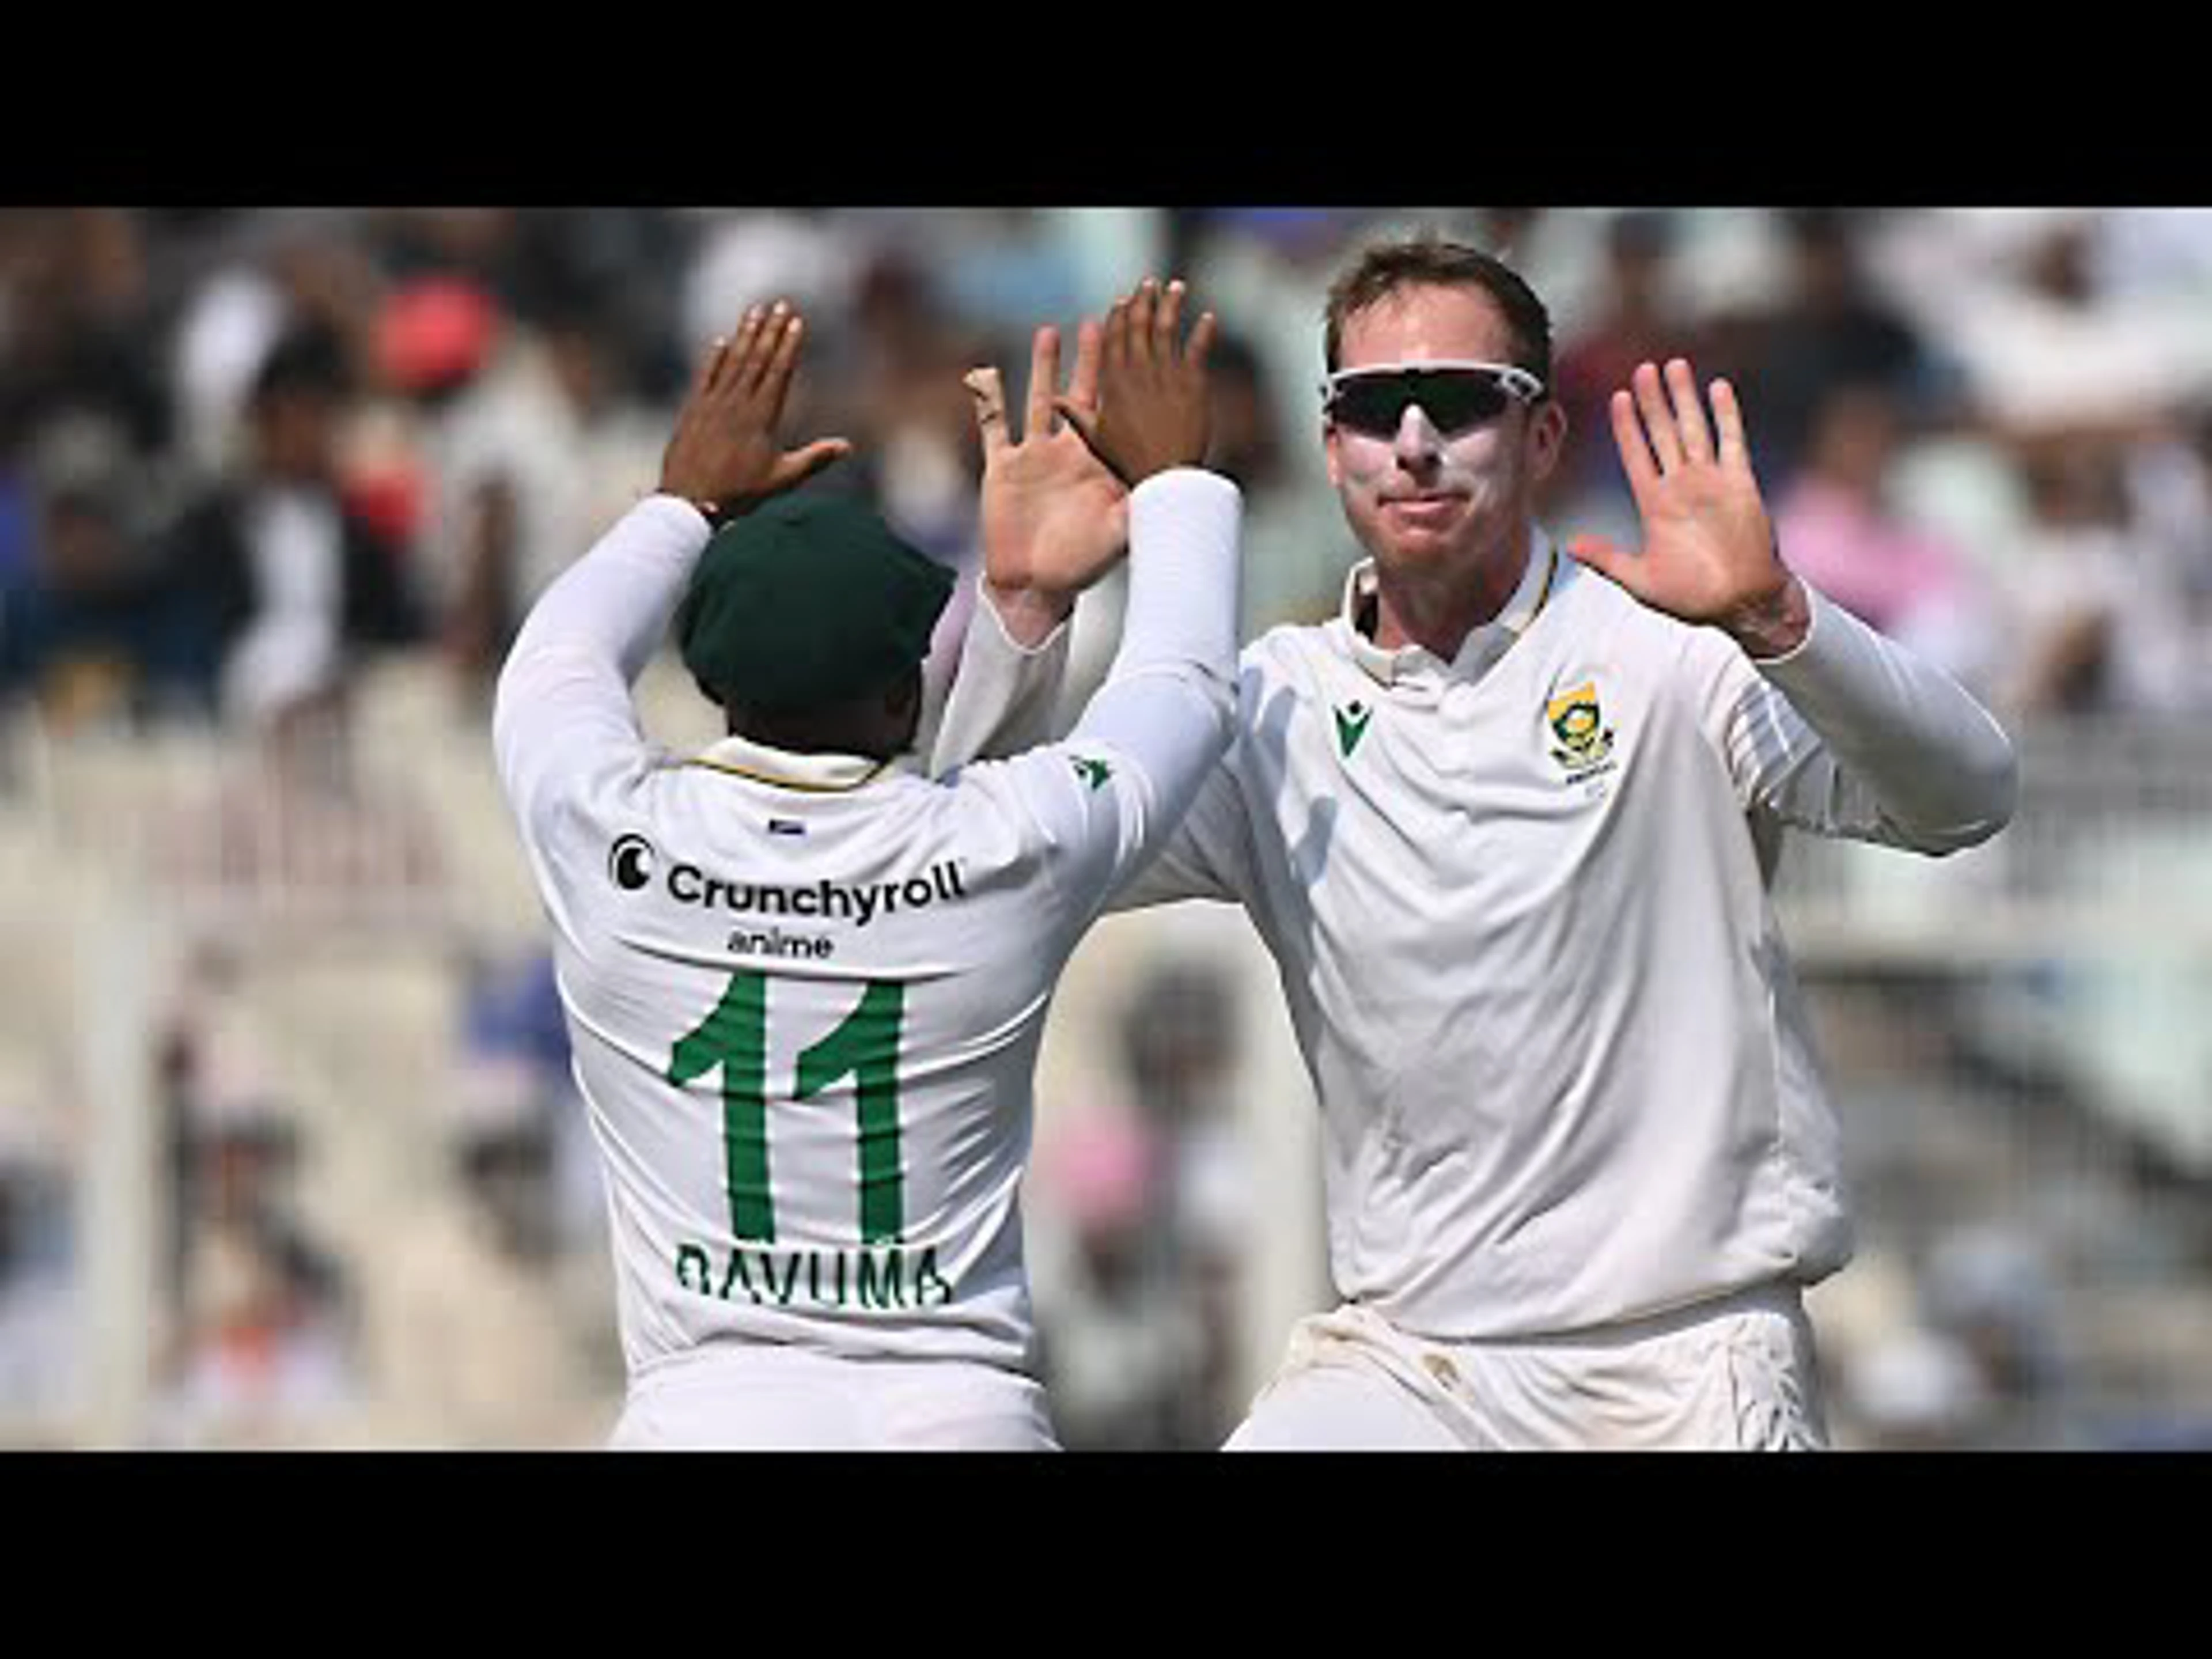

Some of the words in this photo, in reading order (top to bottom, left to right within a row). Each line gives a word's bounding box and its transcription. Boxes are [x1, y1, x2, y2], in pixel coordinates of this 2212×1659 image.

[666, 861, 966, 927] Crunchyroll
[727, 927, 834, 959] anime
[666, 972, 904, 1244] 11
